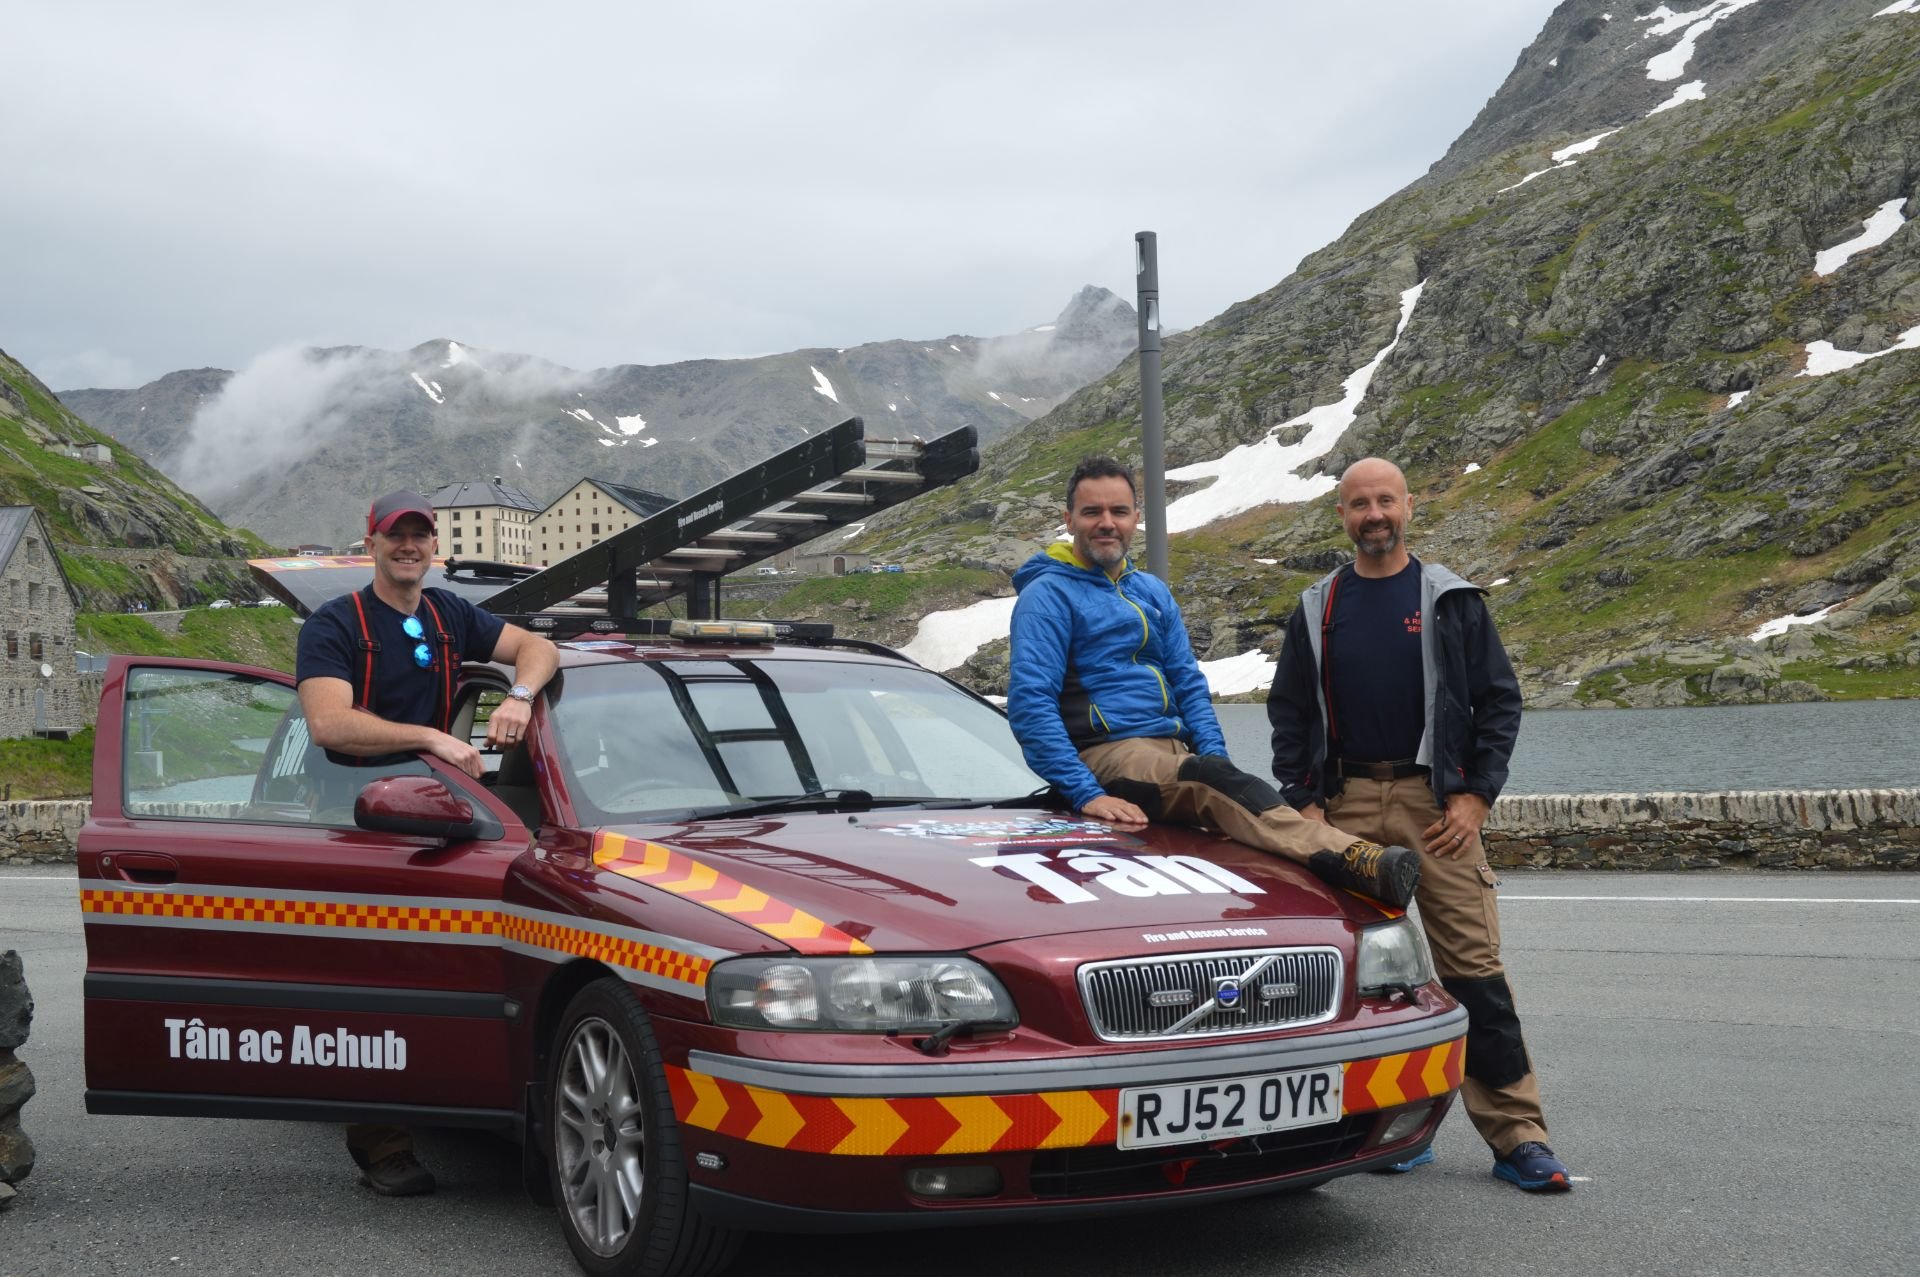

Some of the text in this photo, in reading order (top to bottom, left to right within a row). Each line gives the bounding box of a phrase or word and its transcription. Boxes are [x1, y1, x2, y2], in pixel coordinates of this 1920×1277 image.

[968, 849, 1268, 904] Tân
[1142, 927, 1268, 943] Fire and Rescue Service
[164, 1017, 407, 1071] Tân ac Achub
[1136, 1072, 1330, 1138] RJ52 OYR
